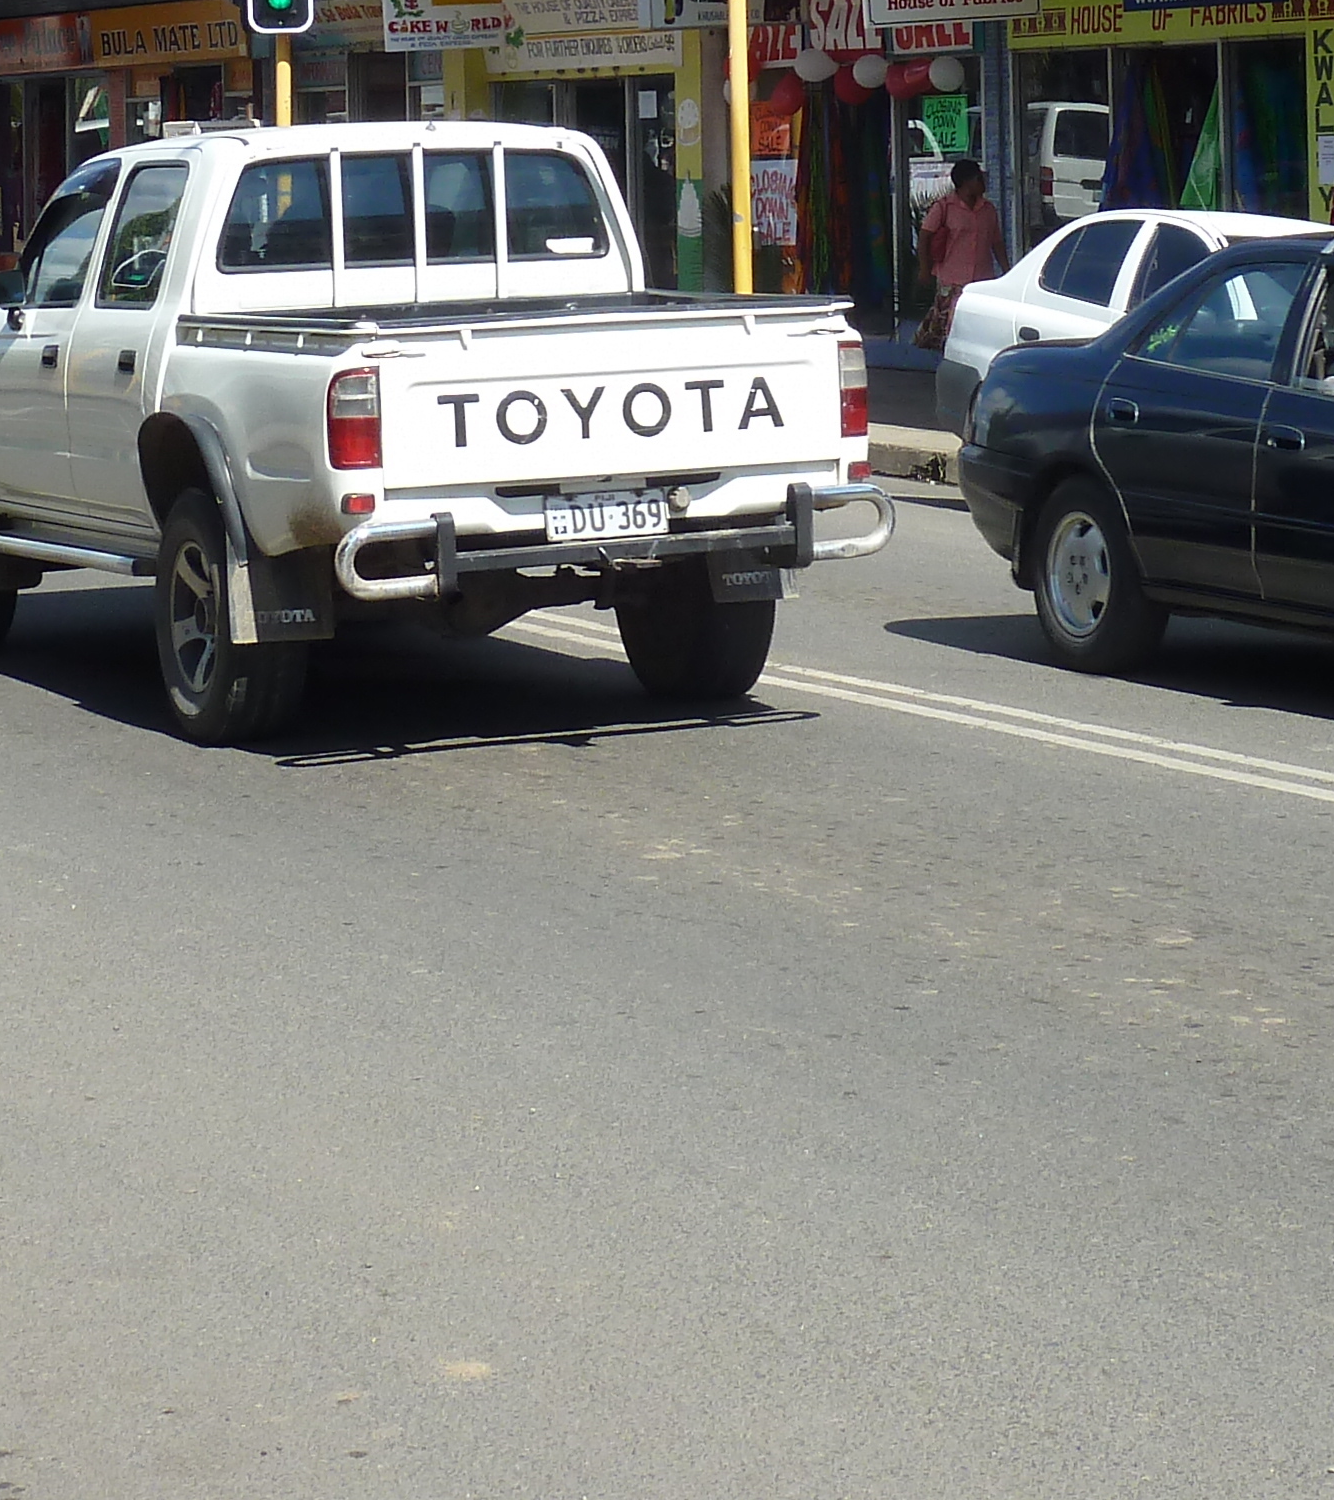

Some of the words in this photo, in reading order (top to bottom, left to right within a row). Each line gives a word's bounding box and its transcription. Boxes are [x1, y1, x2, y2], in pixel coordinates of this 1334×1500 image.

[514, 2, 531, 14] THE
[532, 0, 560, 13] HOUSE
[574, 10, 607, 25] PIZZA
[1071, 3, 1123, 35] HOUSE
[1152, 2, 1173, 31] OF
[1190, 0, 1267, 27] FABRICS
[100, 30, 148, 57] BULA
[154, 25, 201, 53] MATE
[207, 21, 238, 48] LTD
[527, 41, 543, 58] FOR
[545, 39, 579, 58] FURTHER
[925, 98, 963, 120] CLOSING
[1313, 28, 1334, 212] KWALY
[932, 115, 957, 131] DOWN
[755, 198, 789, 221] DOWN
[437, 377, 784, 448] TOYOTA
[570, 503, 605, 534] DU
[616, 498, 661, 530] 369
